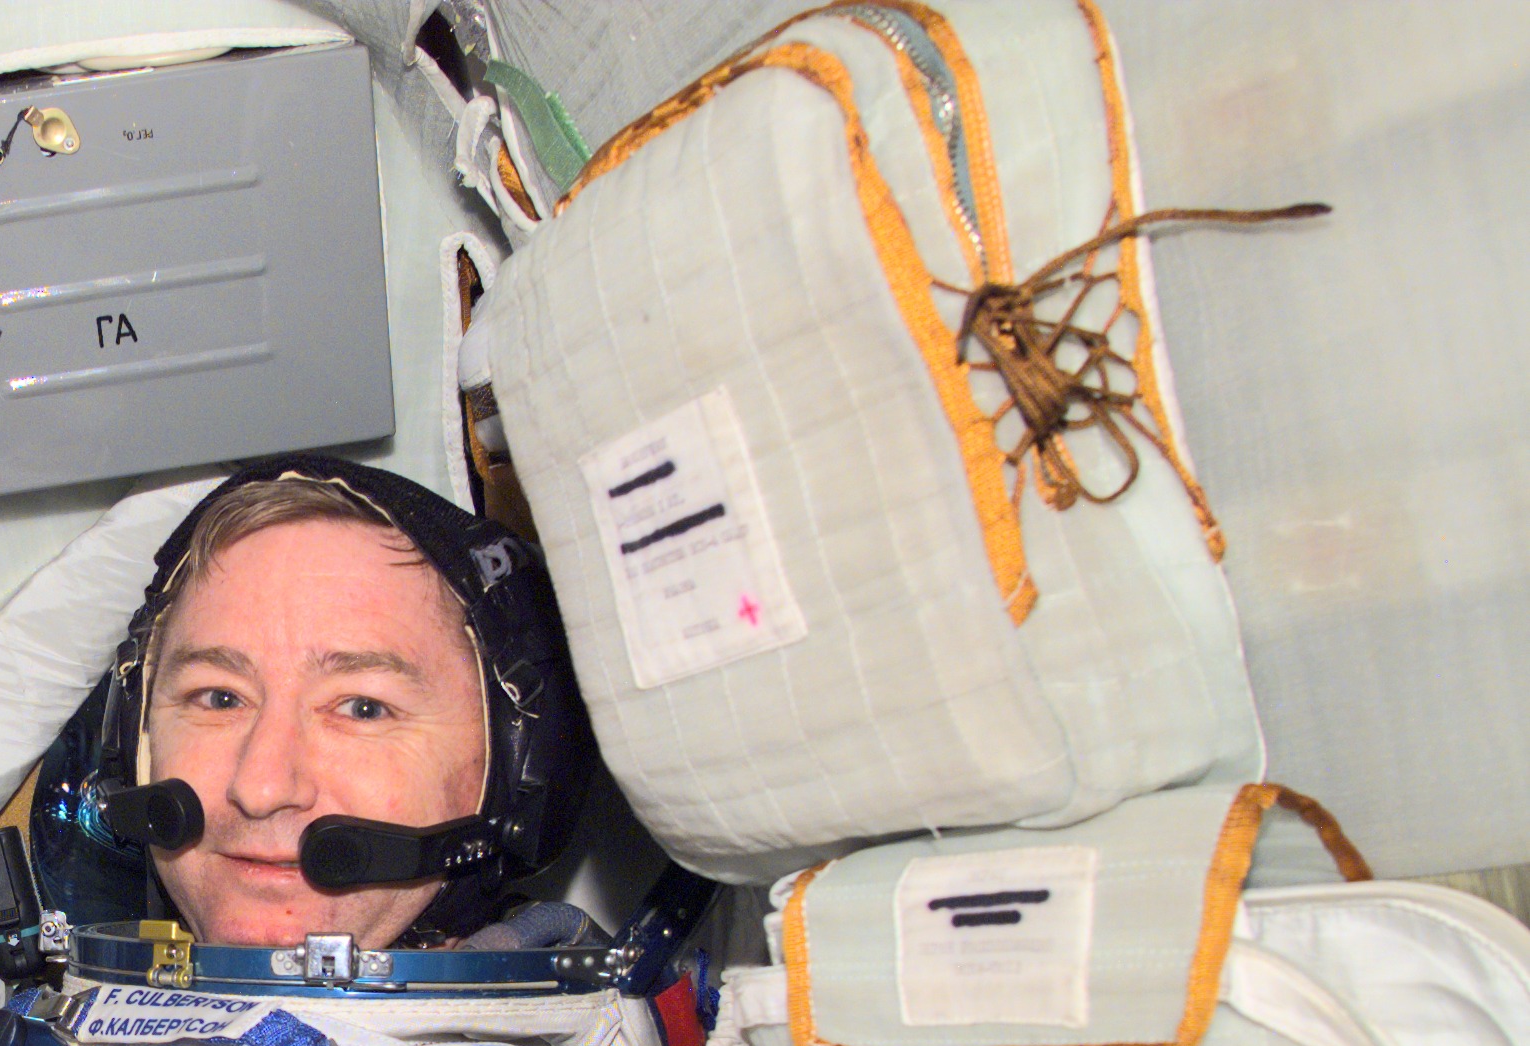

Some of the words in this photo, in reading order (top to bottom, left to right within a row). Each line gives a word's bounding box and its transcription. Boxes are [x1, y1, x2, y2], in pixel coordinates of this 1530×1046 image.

[96, 313, 138, 348] ГА
[104, 988, 122, 1005] F.
[125, 989, 262, 1013] CULBERTSON
